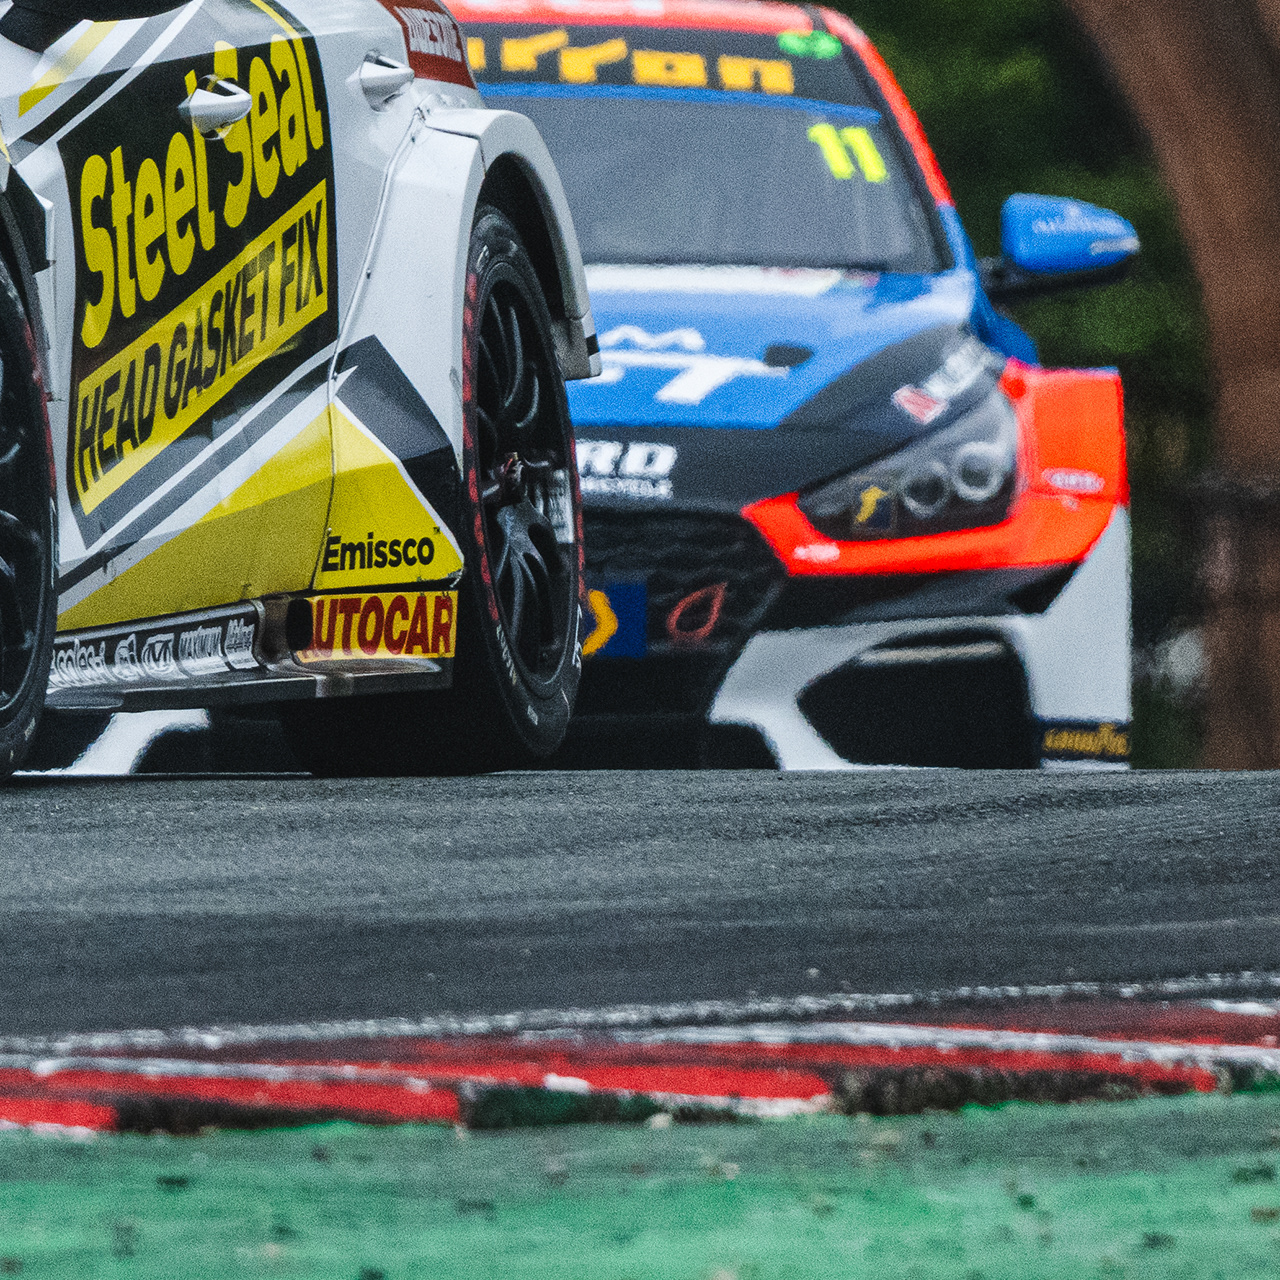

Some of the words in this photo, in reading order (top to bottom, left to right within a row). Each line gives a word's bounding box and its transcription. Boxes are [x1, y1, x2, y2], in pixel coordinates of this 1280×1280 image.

[807, 122, 888, 183] 11
[80, 69, 216, 349] Steel
[212, 33, 324, 229] Seal
[77, 341, 162, 493] HEAD
[163, 240, 277, 414] GASKET
[279, 199, 325, 328] FIX
[321, 531, 435, 573] Emissco
[303, 595, 453, 658] UTOCAR
